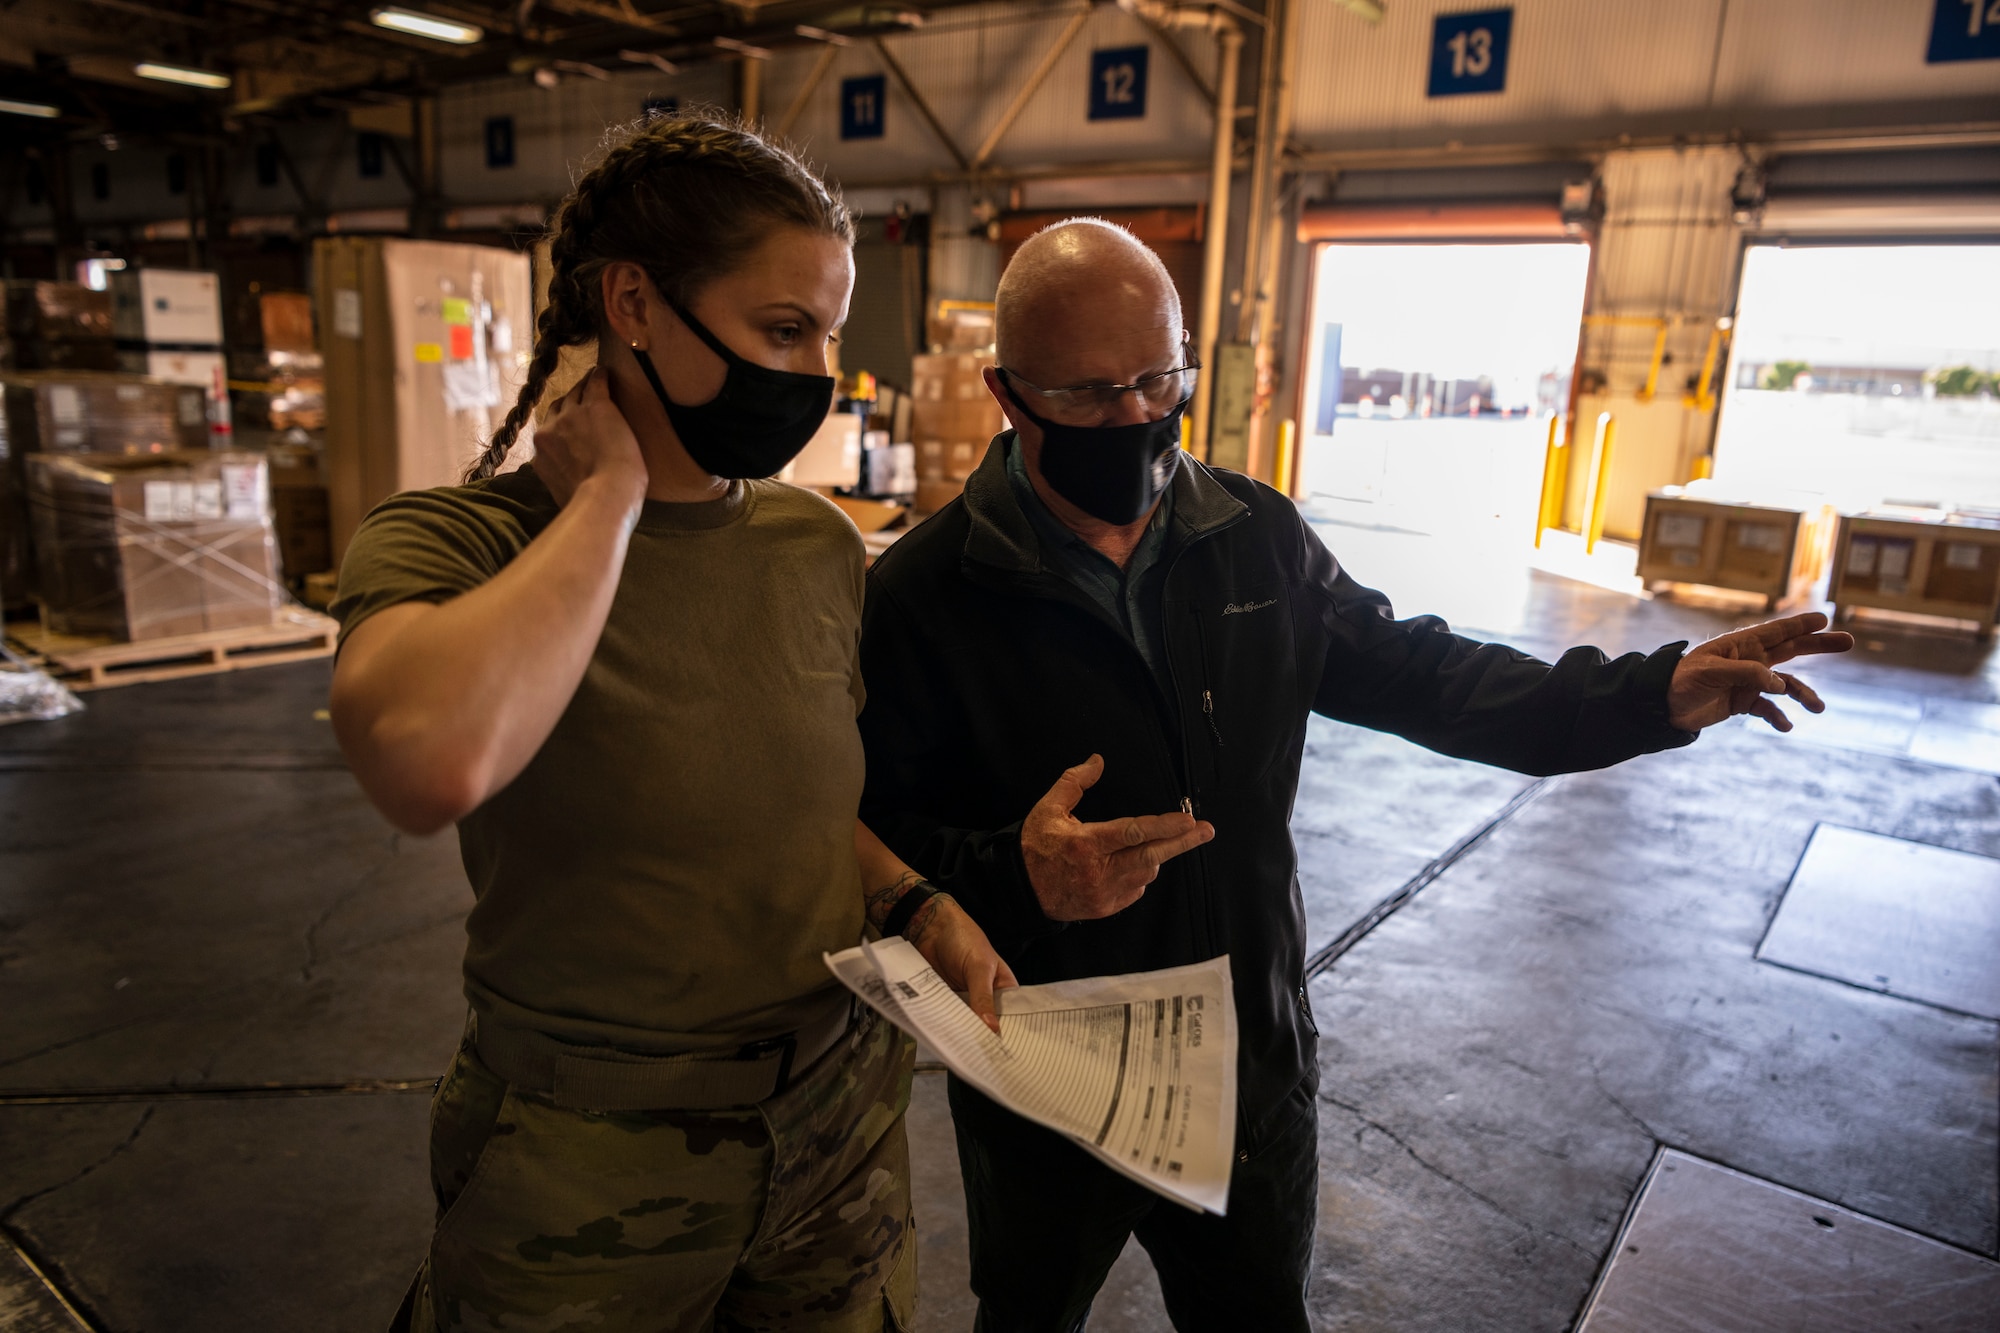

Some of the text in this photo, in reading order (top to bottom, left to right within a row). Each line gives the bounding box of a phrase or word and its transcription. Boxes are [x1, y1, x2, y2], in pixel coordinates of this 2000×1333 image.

[1446, 28, 1493, 78] 13
[1101, 63, 1136, 105] 12
[850, 90, 876, 127] 11
[1244, 600, 1277, 613] Bauer
